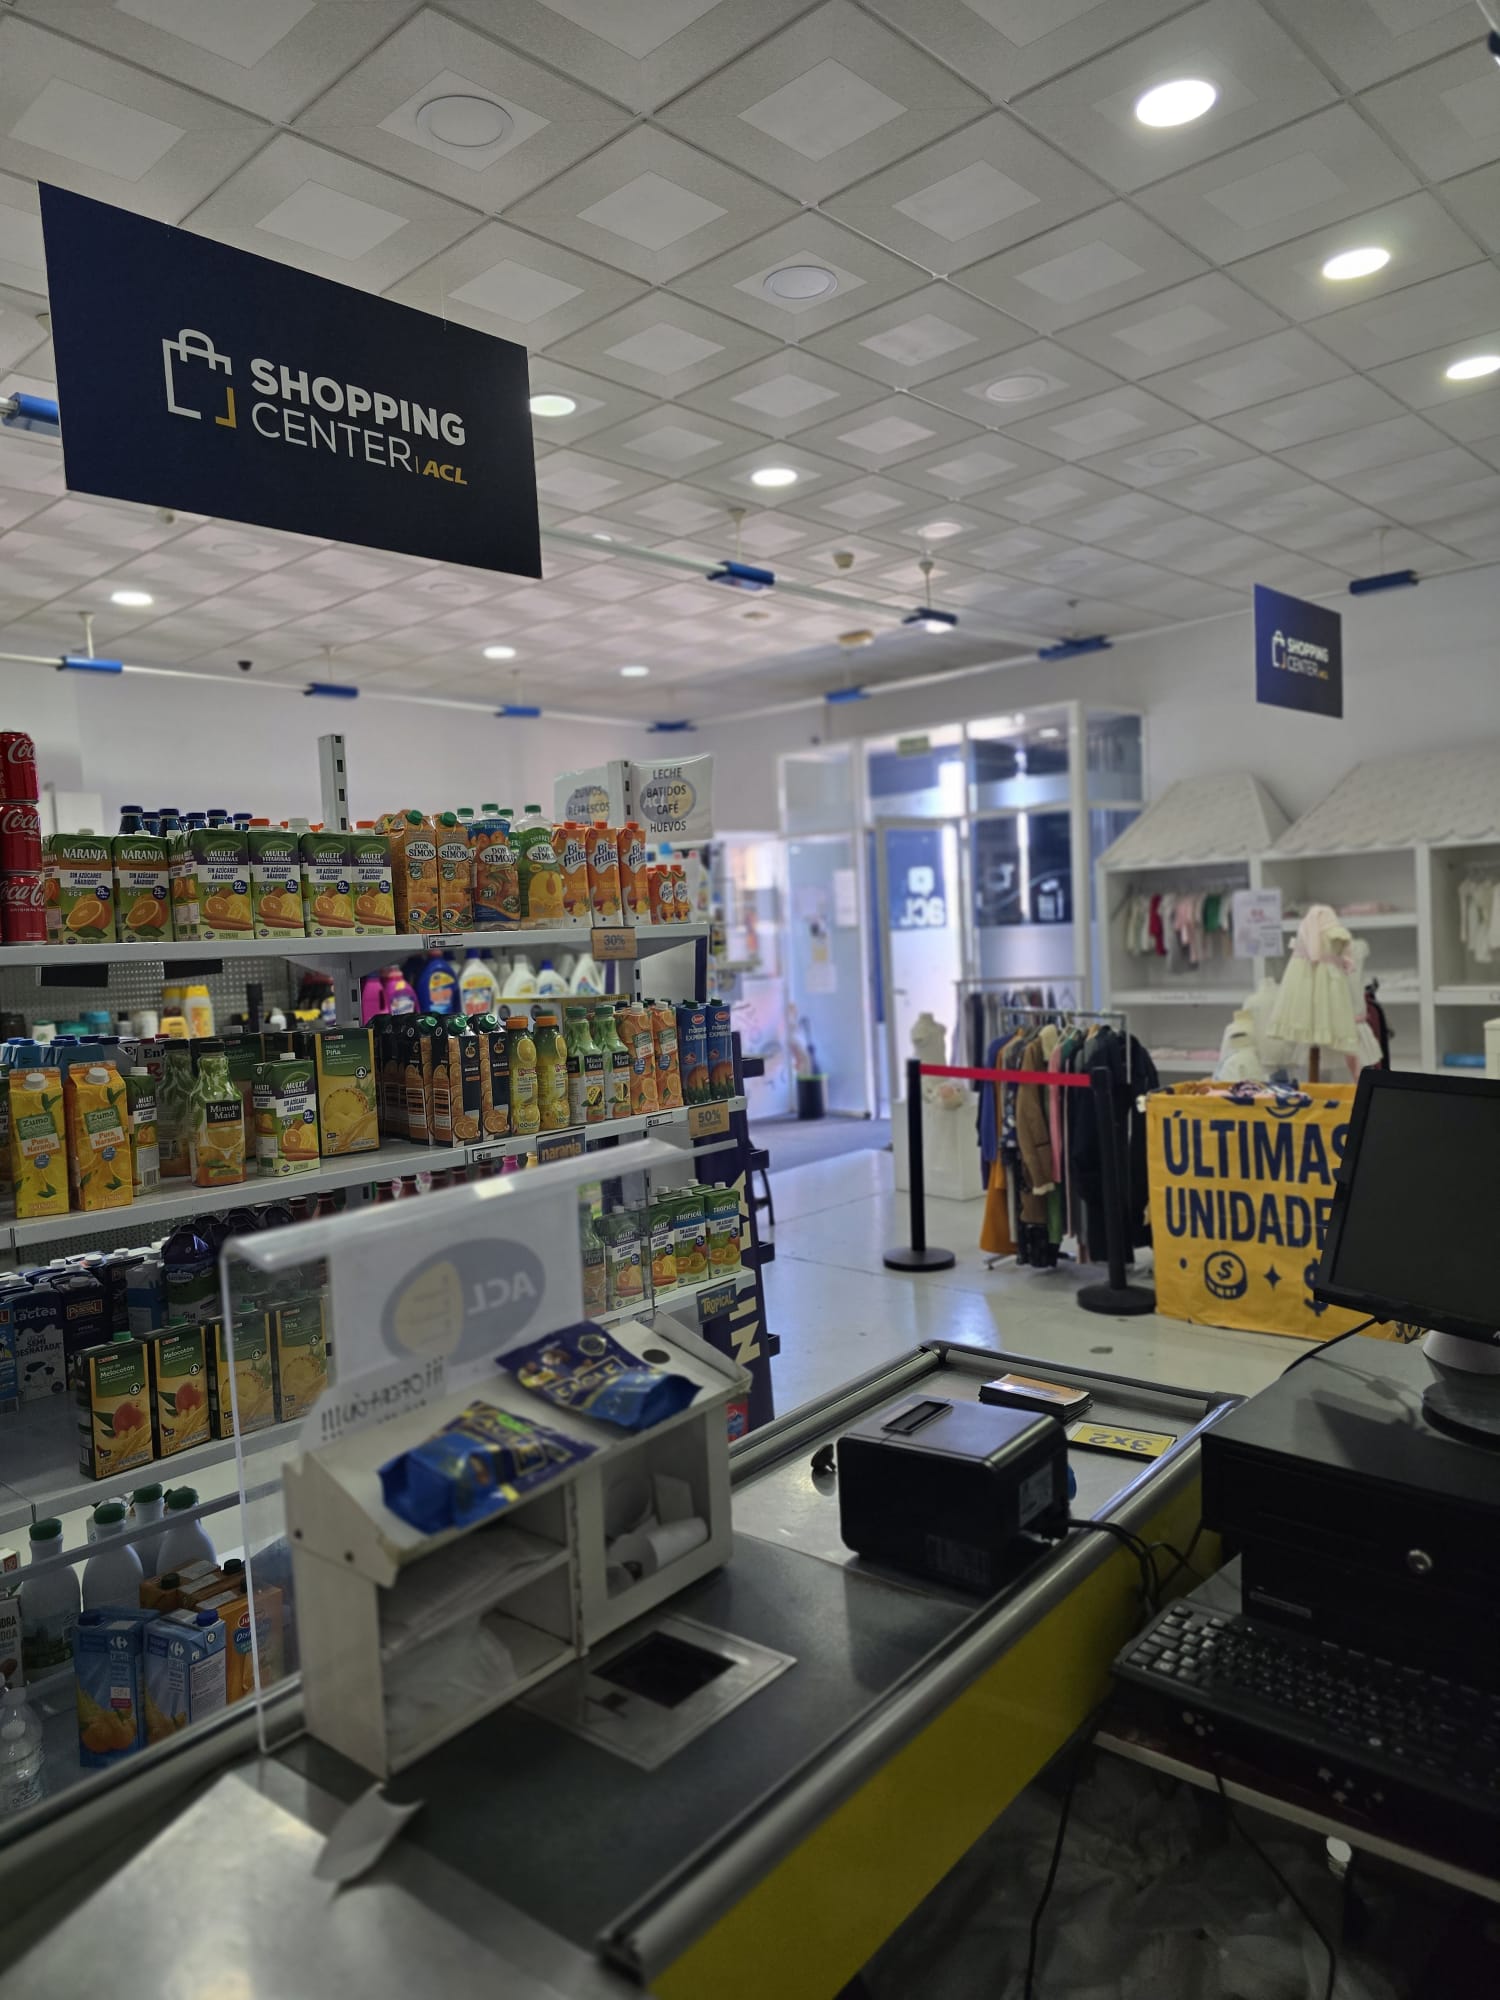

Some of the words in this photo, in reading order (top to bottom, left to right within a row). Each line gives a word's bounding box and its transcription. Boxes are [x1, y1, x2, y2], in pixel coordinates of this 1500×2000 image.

[250, 358, 465, 446] SHOPPING
[252, 402, 413, 472] CENTER
[423, 460, 467, 485] ACL
[1287, 637, 1328, 663] SHOPPING
[1287, 655, 1318, 676] CENTER
[653, 767, 682, 780] LECHE
[646, 785, 686, 799] BATIDOS
[656, 801, 679, 815] CAFÉ
[650, 821, 687, 833] HUEVOS
[62, 848, 108, 861] NARANJA
[121, 849, 164, 861] NARANJA
[408, 849, 434, 857] SIMON
[441, 850, 467, 858] SIMON
[568, 843, 577, 856] Bi
[597, 843, 607, 856] Bi
[632, 843, 640, 856] Bi
[287, 881, 294, 889] 22
[604, 935, 625, 946] 30%
[326, 1048, 341, 1056] Piña
[210, 1104, 240, 1113] Minute
[214, 1110, 236, 1119] Maid
[22, 1117, 49, 1128] Zumo
[91, 1111, 115, 1122] Zumo
[698, 1109, 721, 1123] 50%
[541, 1138, 582, 1162] naranja
[1163, 1110, 1351, 1186] ÚLTIMAS
[713, 1203, 737, 1213] TROPICAL
[676, 1210, 702, 1221] TROPICAL
[1166, 1186, 1334, 1250] UNIDADE
[163, 1346, 195, 1360] Melocotón
[100, 1365, 135, 1378] Melocotón
[1088, 1432, 1153, 1452] 3x2
